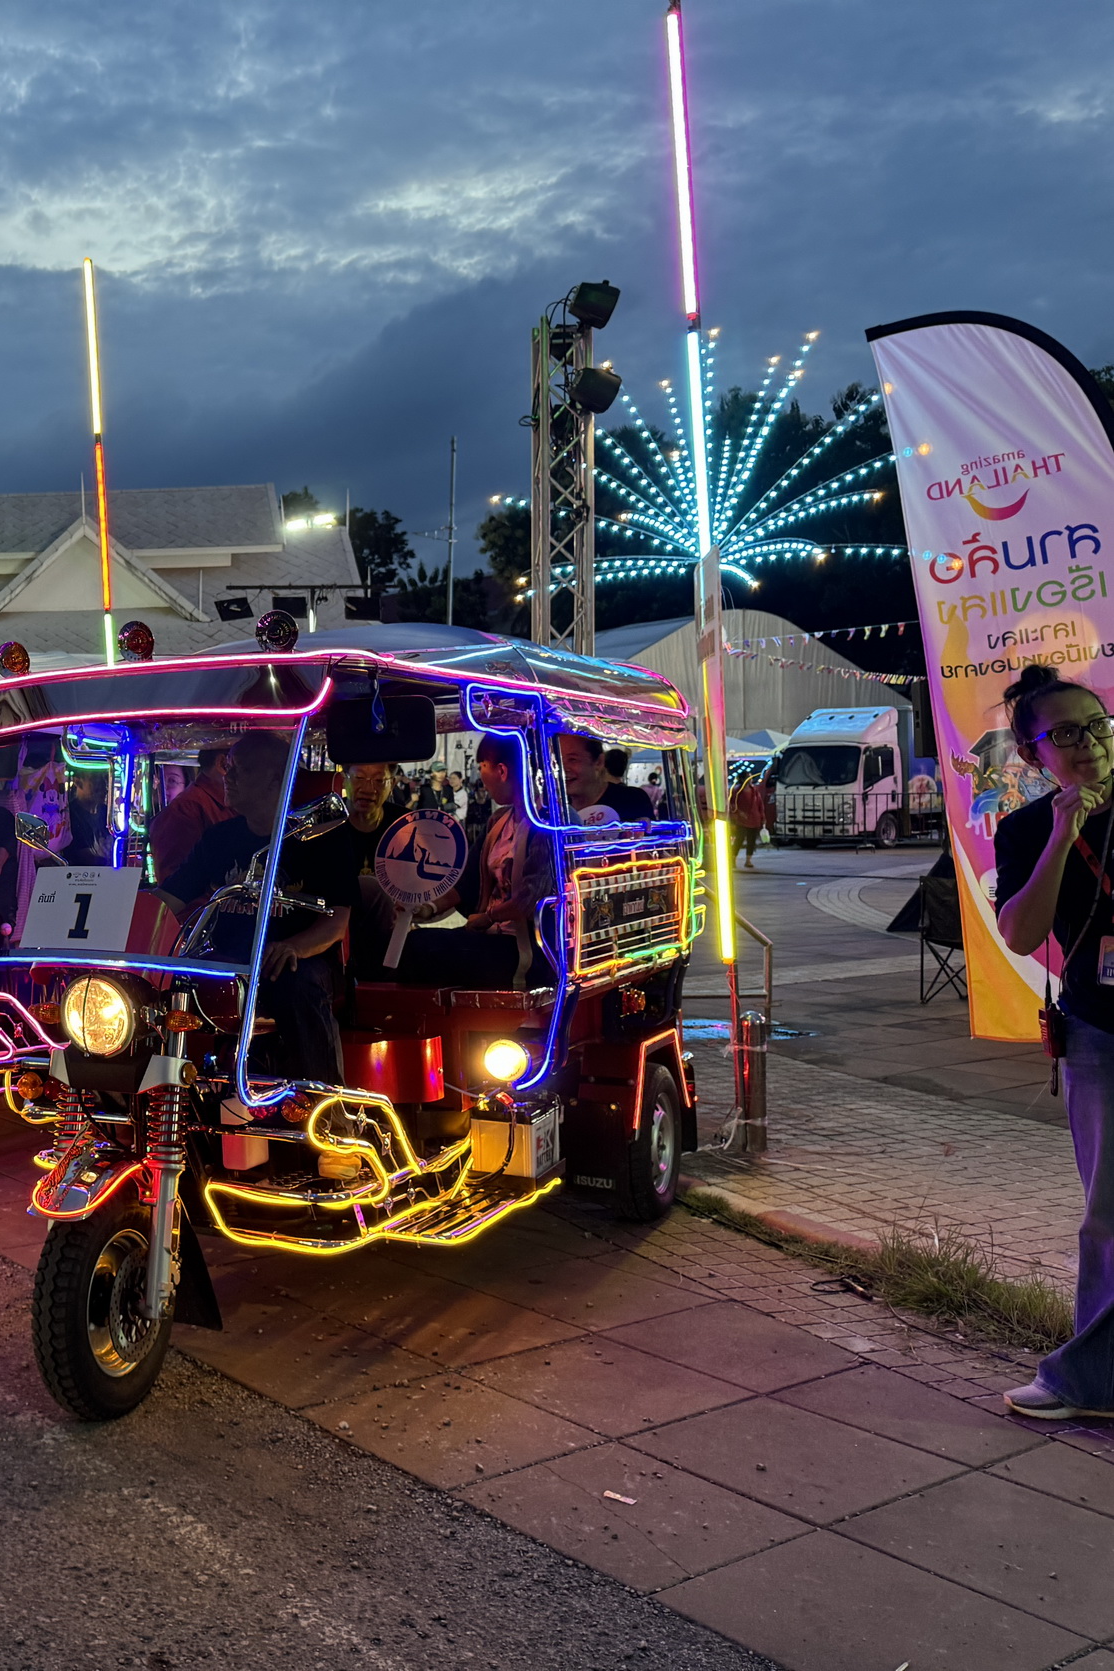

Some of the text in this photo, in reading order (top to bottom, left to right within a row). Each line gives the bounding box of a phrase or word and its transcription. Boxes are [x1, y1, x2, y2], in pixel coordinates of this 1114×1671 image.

[433, 868, 460, 897] THAILAND
[37, 891, 57, 904] คันที่
[66, 893, 93, 939] 1
[576, 1175, 613, 1189] ISUZU
